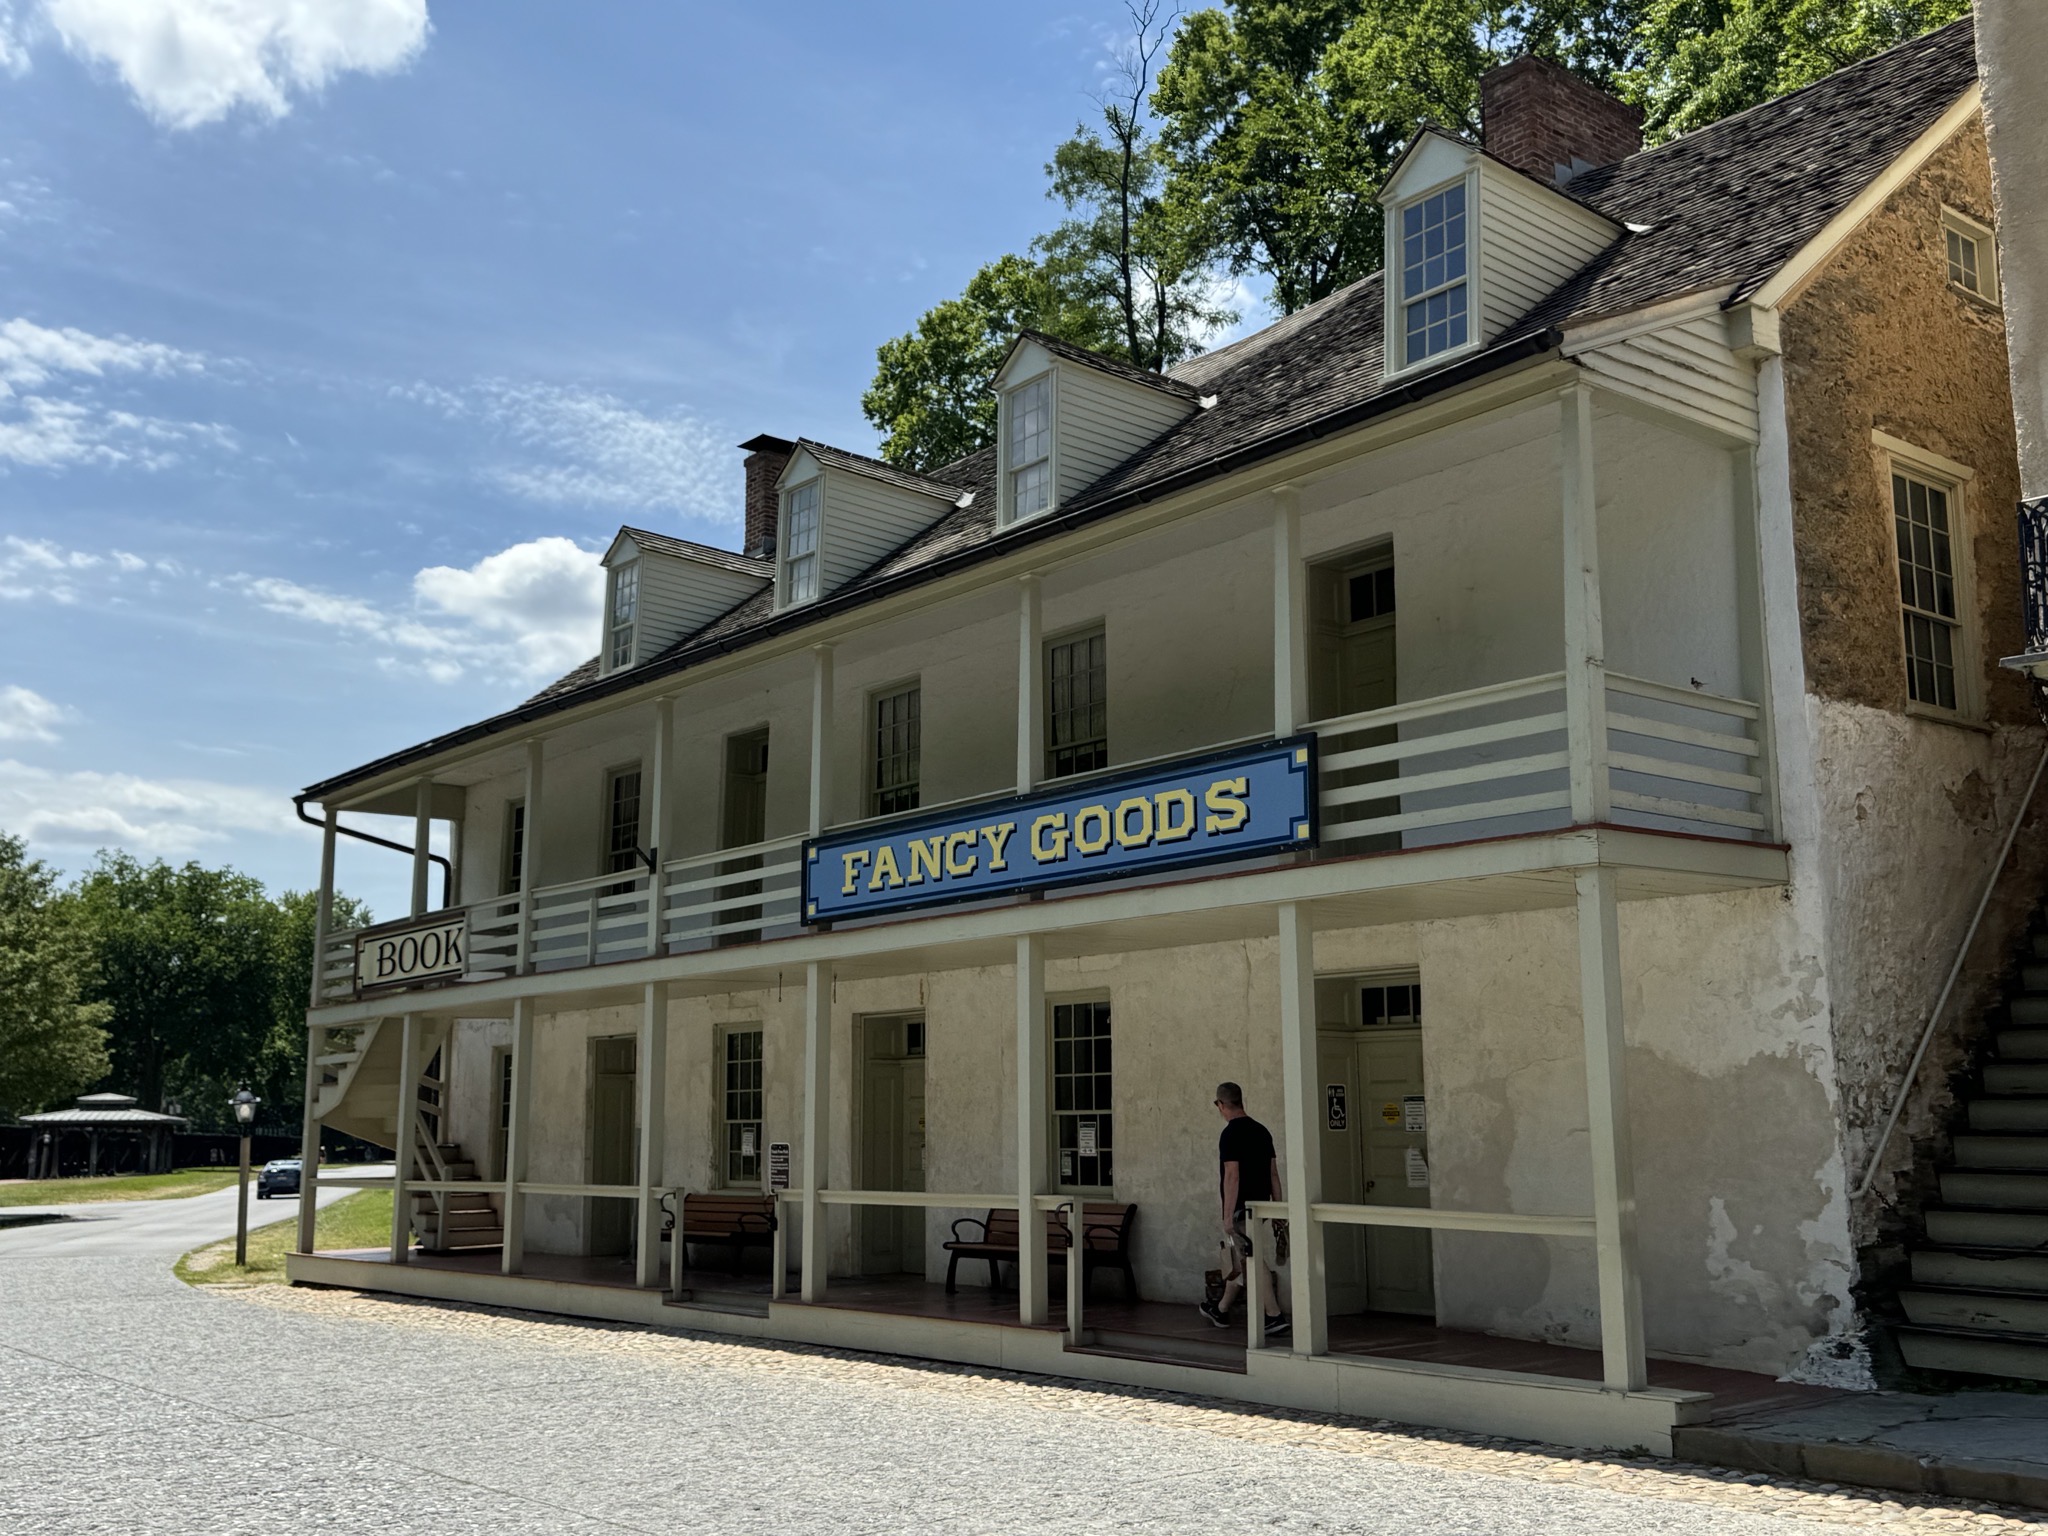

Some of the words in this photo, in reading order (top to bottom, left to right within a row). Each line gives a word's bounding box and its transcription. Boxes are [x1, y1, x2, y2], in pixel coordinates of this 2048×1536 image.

[841, 822, 1017, 895] FANCY
[1031, 777, 1251, 863] GOODS
[377, 928, 462, 977] BOOK
